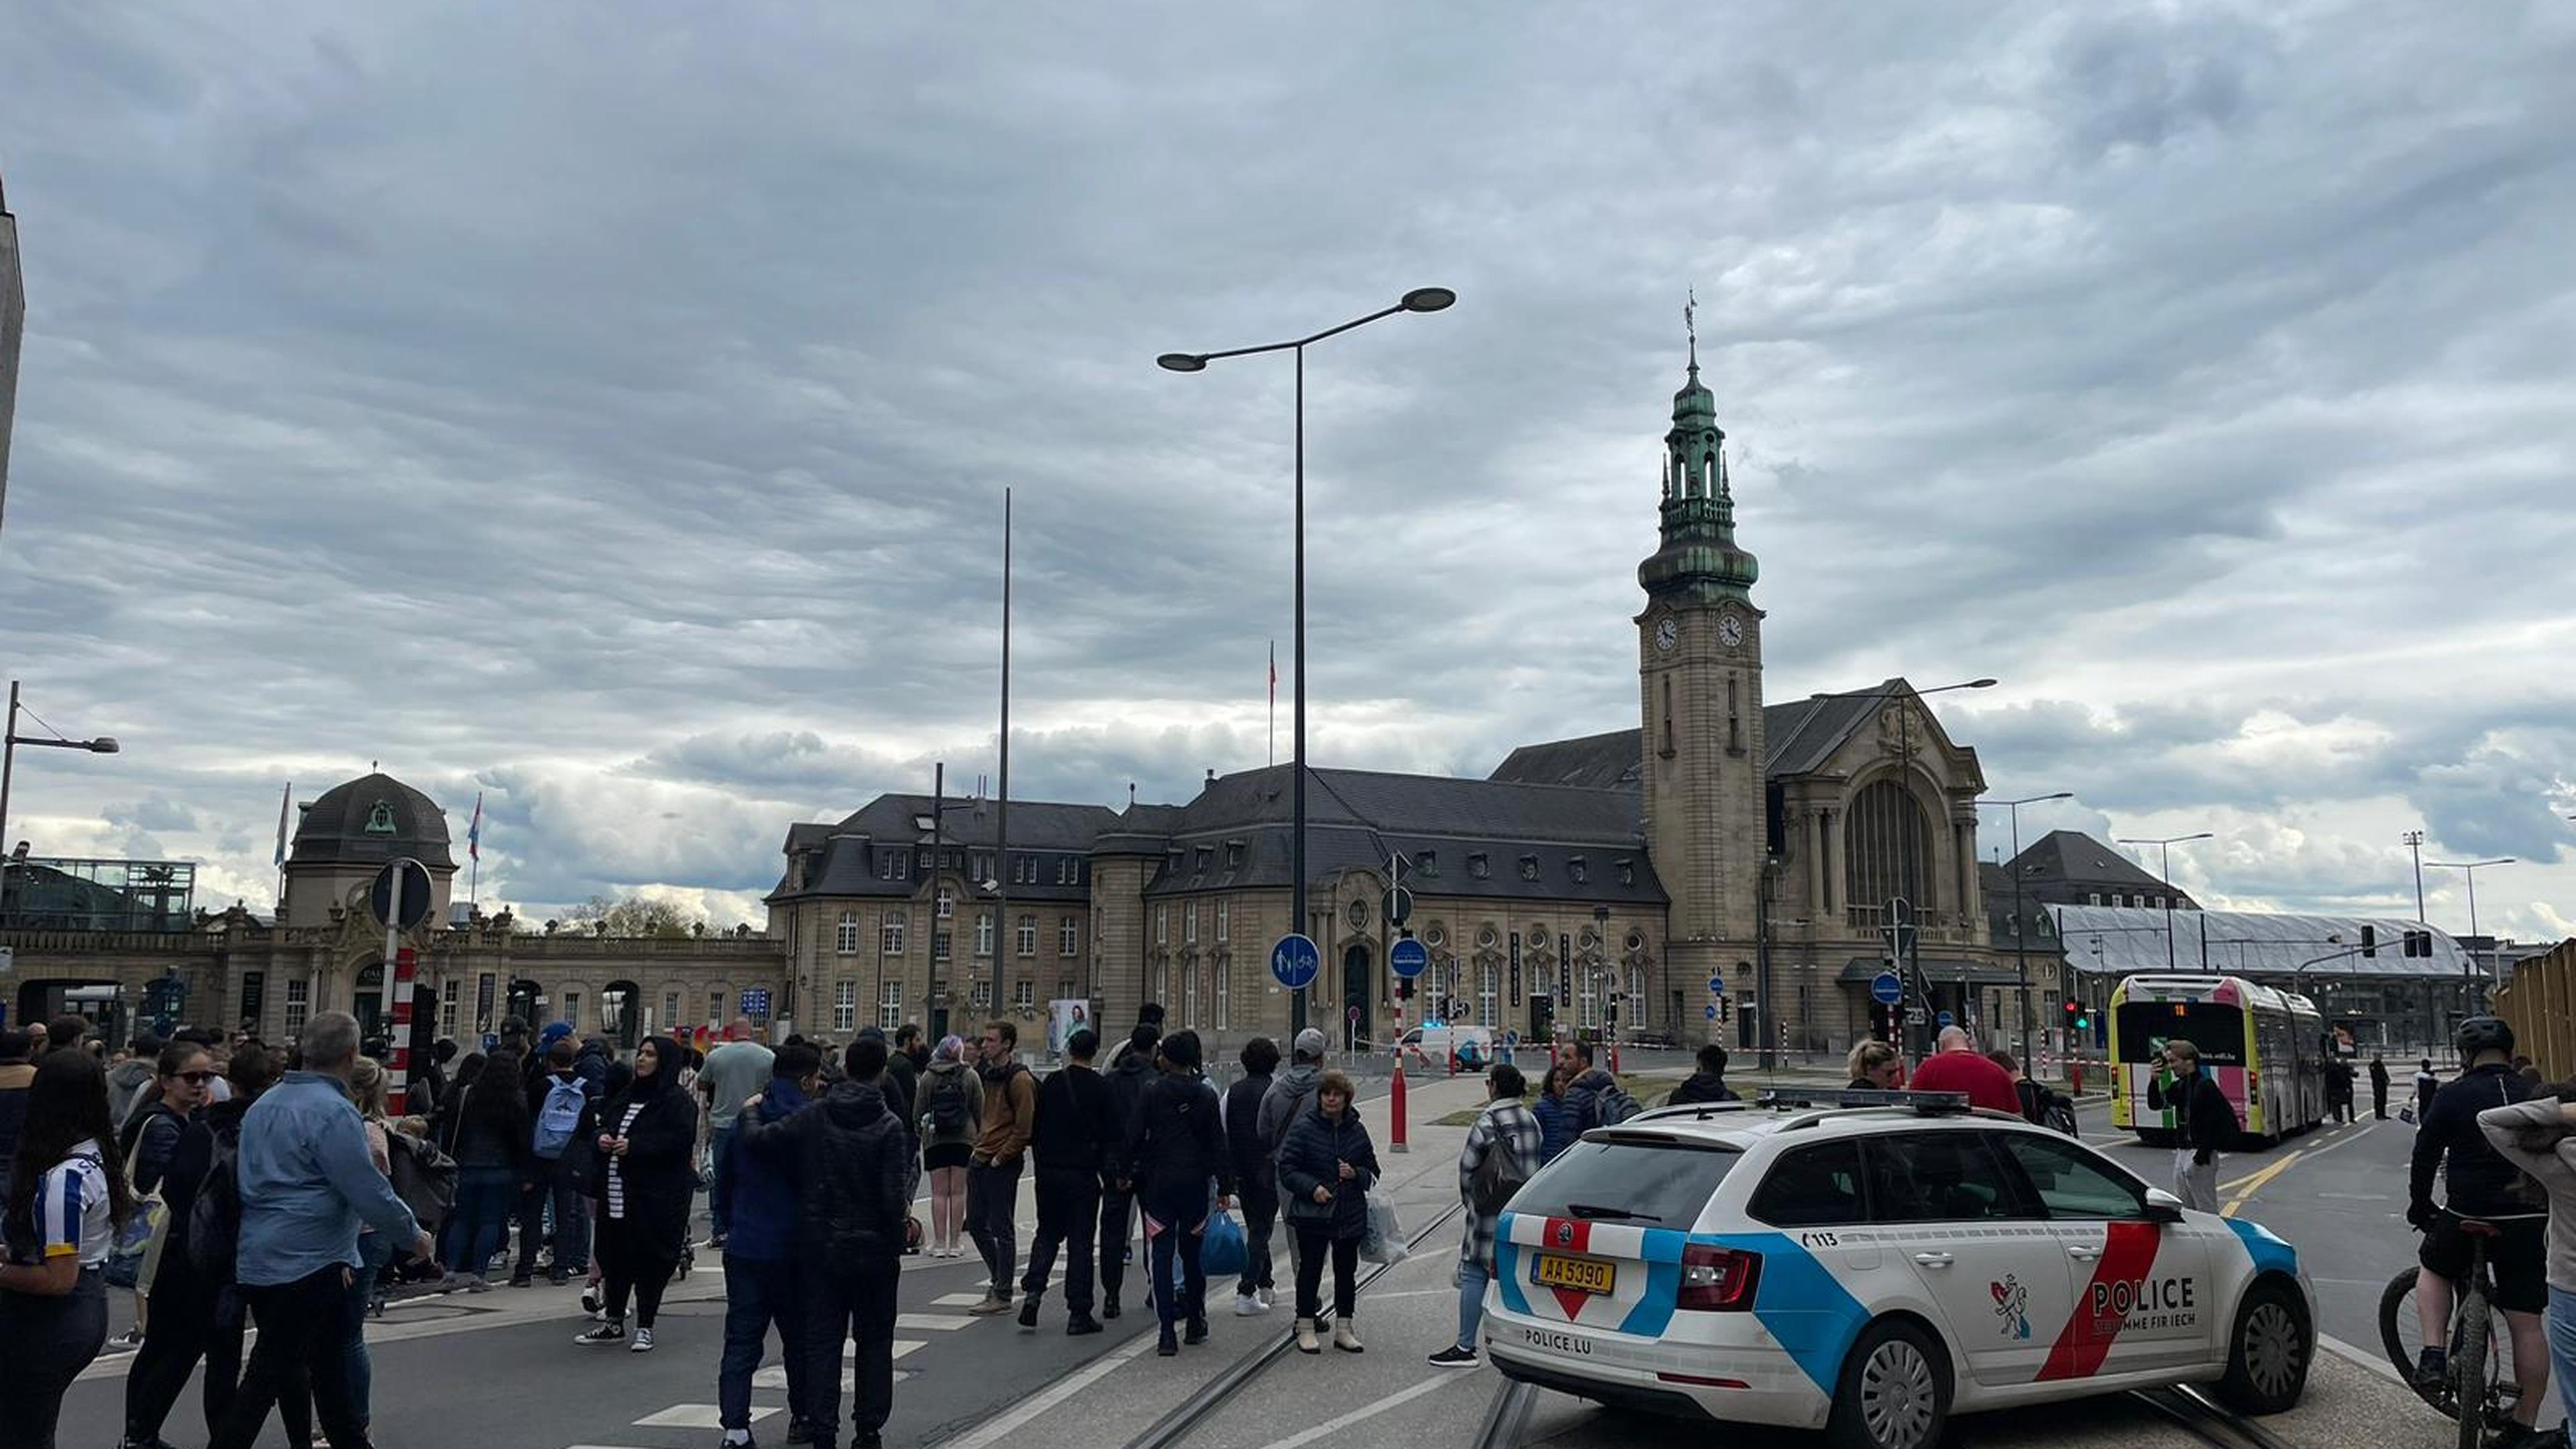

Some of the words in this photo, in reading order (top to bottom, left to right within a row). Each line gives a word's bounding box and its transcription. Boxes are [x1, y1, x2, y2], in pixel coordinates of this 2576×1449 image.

[1811, 1232, 1838, 1246] 113
[1546, 1258, 1563, 1280] AA
[1566, 1262, 1604, 1286] 5390
[2092, 1277, 2194, 1318] POLICE
[2151, 1316, 2167, 1328] FIR
[2171, 1313, 2196, 1326] IECH
[1525, 1329, 1591, 1355] POLICE.LU
